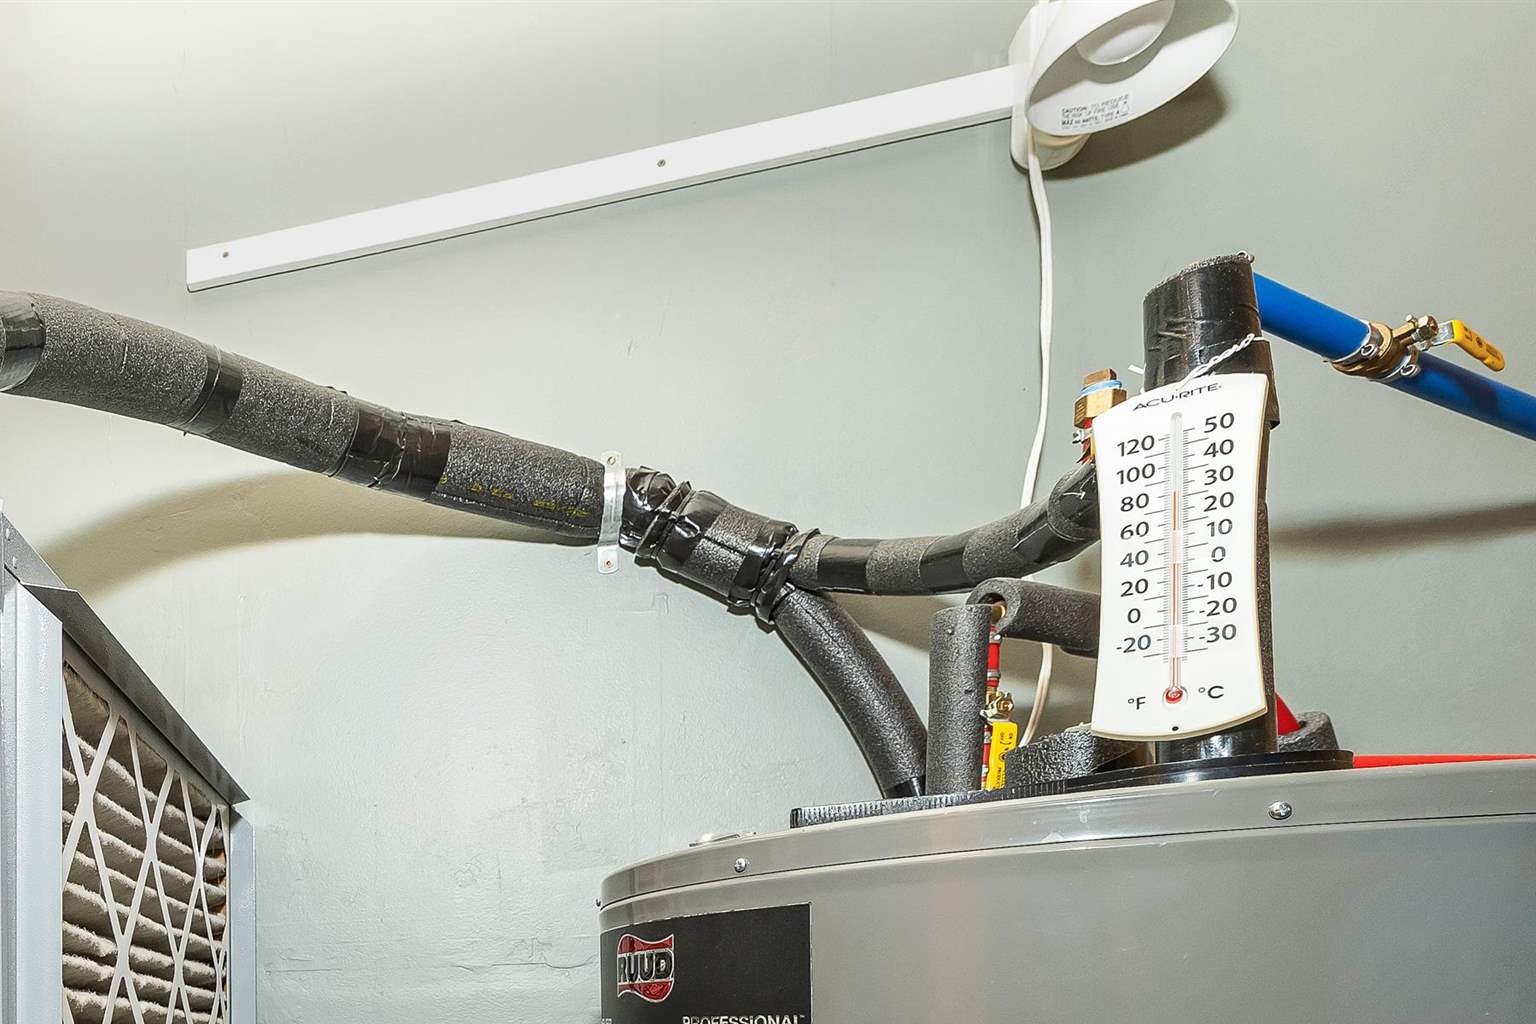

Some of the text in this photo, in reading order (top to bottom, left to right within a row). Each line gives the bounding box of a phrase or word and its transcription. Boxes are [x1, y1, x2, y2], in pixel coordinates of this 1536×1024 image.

[1204, 412, 1235, 434] 50
[1116, 435, 1155, 457] 120
[1203, 439, 1235, 459] 40
[1116, 463, 1156, 485] 100
[1204, 465, 1234, 486] 30
[1120, 492, 1149, 513] 80
[1203, 491, 1235, 512] 20
[1120, 520, 1149, 540] 60
[1206, 518, 1233, 538] 10
[1119, 549, 1149, 568] 40
[1211, 546, 1226, 562] 0
[1120, 578, 1149, 597] 20
[1196, 570, 1233, 591] -10
[1127, 607, 1141, 624] 0
[1199, 596, 1237, 618] -20
[1116, 634, 1151, 654] -20
[1199, 623, 1237, 645] -30
[617, 950, 674, 984] RUUD
